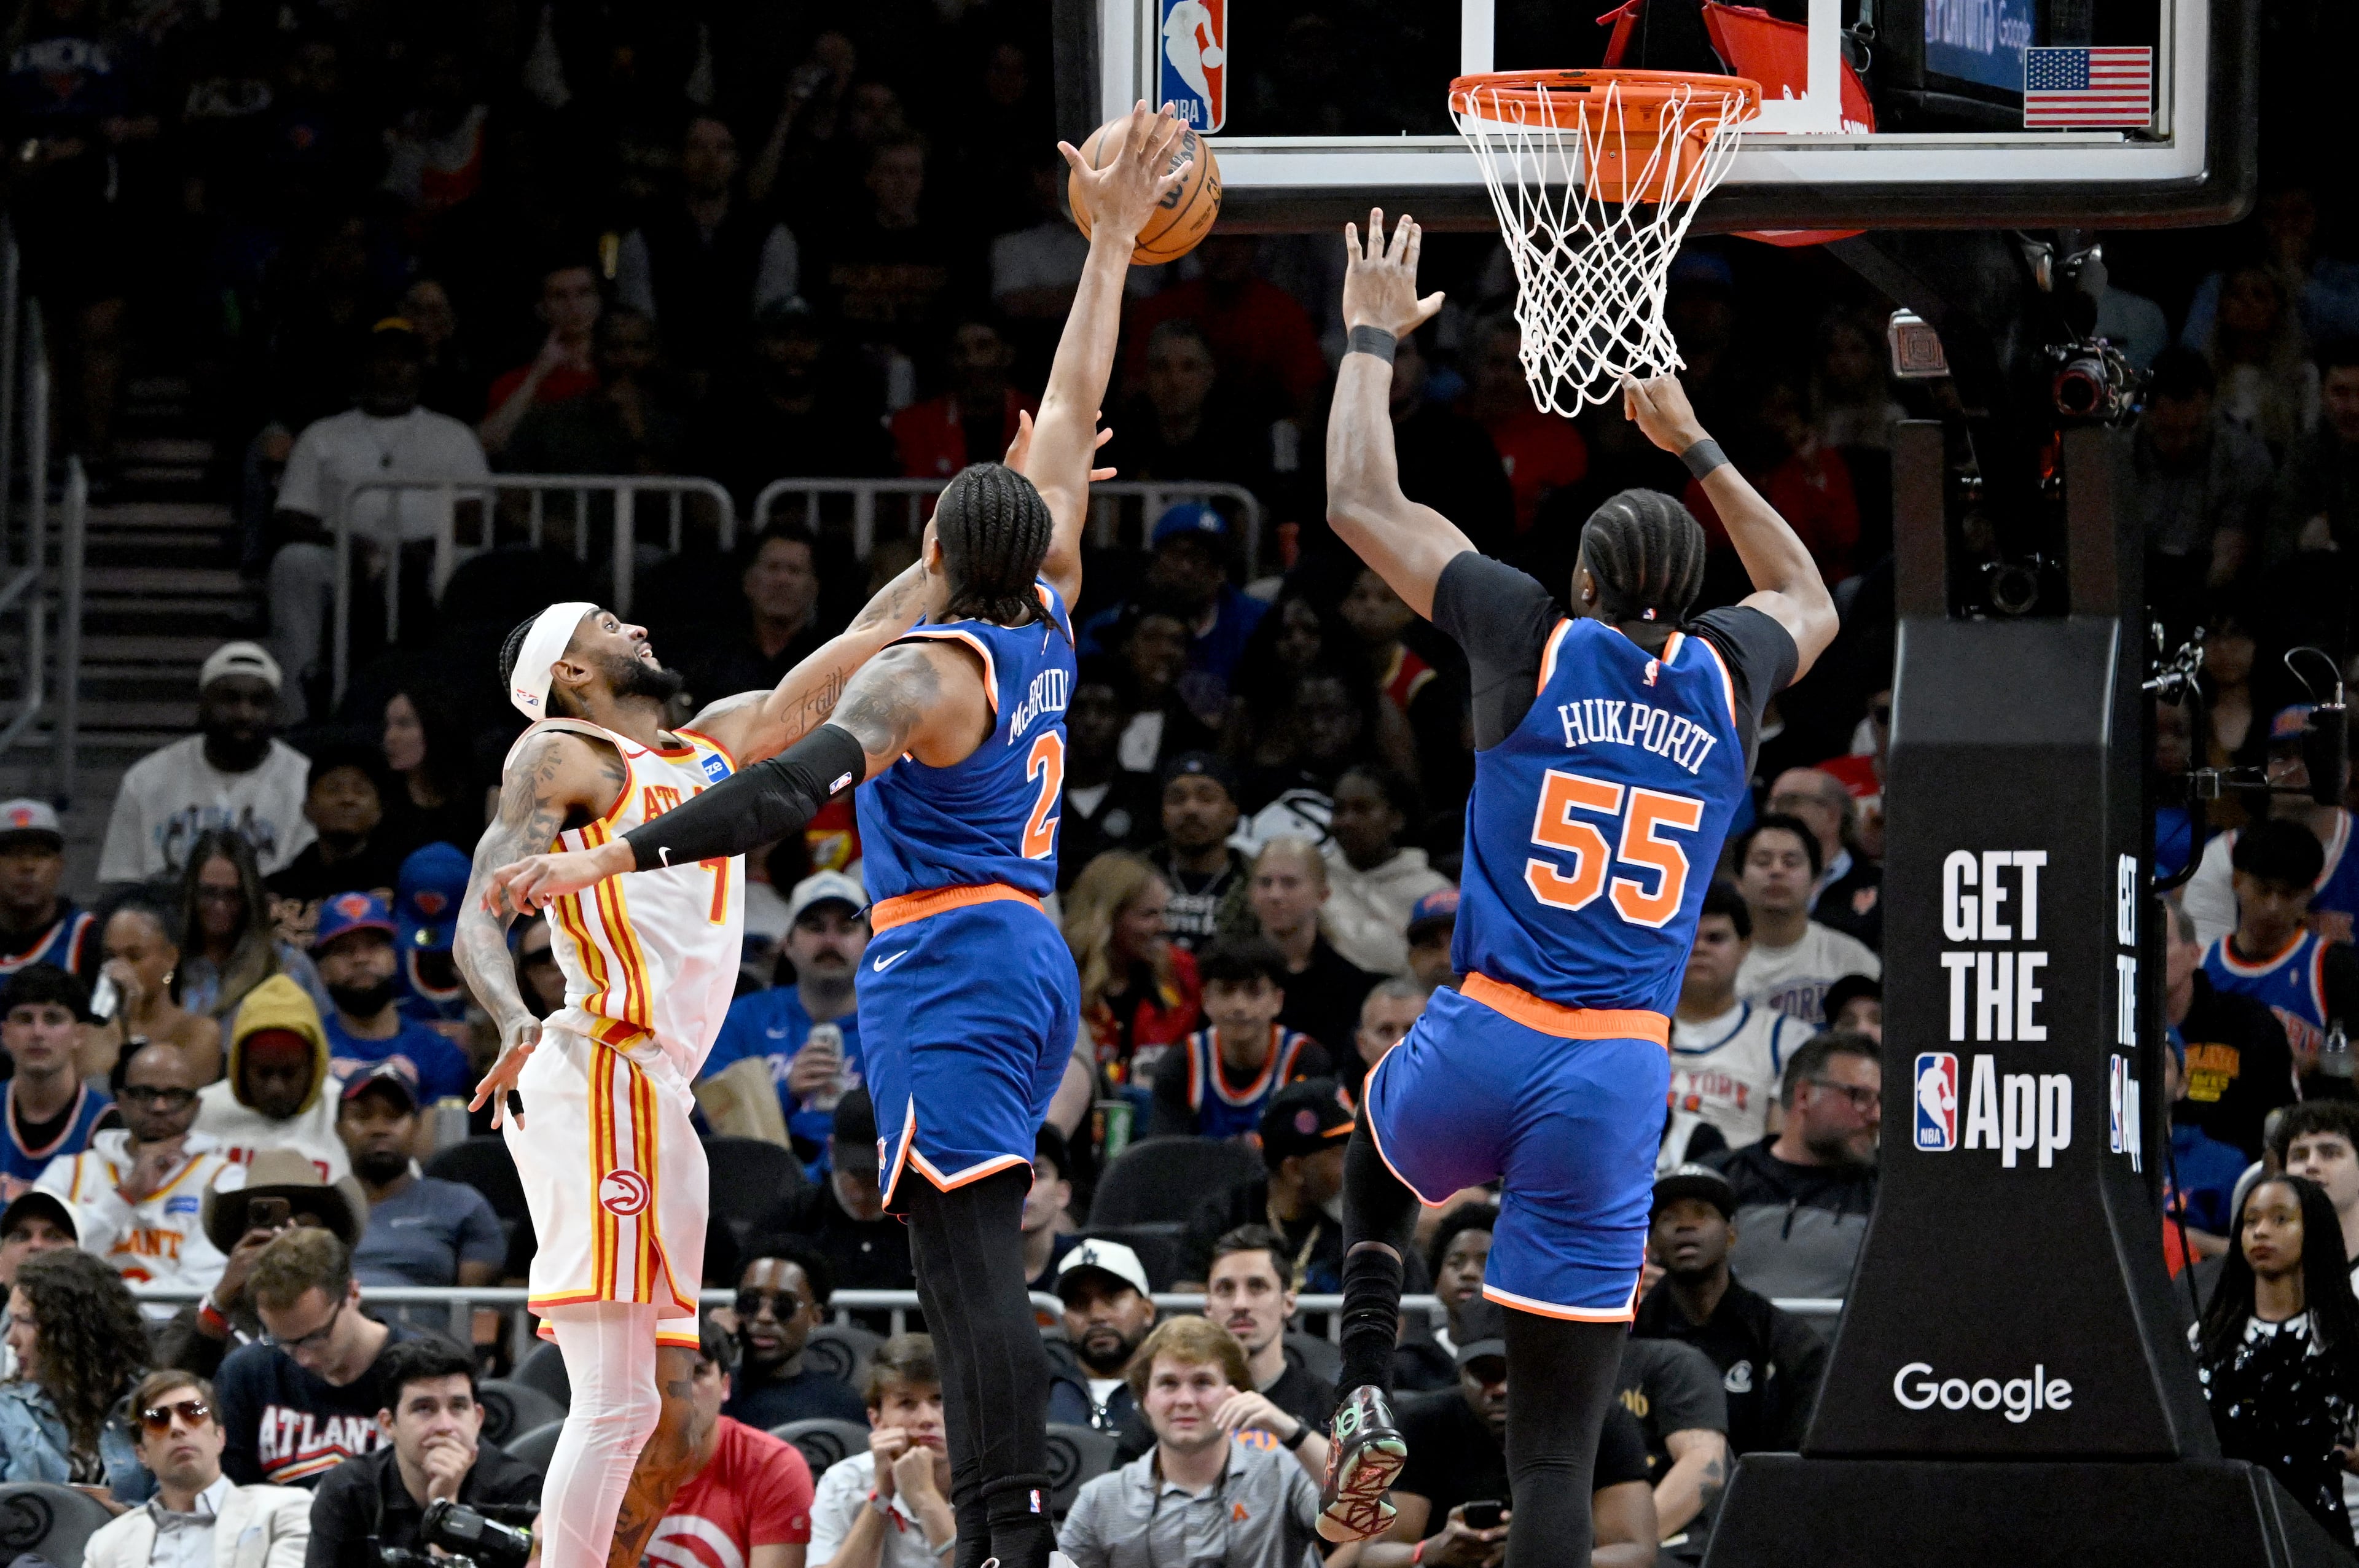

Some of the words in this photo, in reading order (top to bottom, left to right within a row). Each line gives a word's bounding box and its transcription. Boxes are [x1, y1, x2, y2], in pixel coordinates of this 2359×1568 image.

[1168, 99, 1200, 123] NBA
[704, 761, 723, 776] ze
[1557, 698, 1718, 775] HUKPORTI
[1021, 729, 1064, 860] 2
[1524, 768, 1705, 929] 55
[1942, 849, 2048, 942] GET
[2118, 852, 2137, 947] GET
[1941, 951, 2048, 1042] THE
[2117, 954, 2137, 1047] THE
[1920, 1128, 1941, 1145] NBA
[1964, 1053, 2072, 1168] App
[1893, 1362, 2073, 1424] Google
